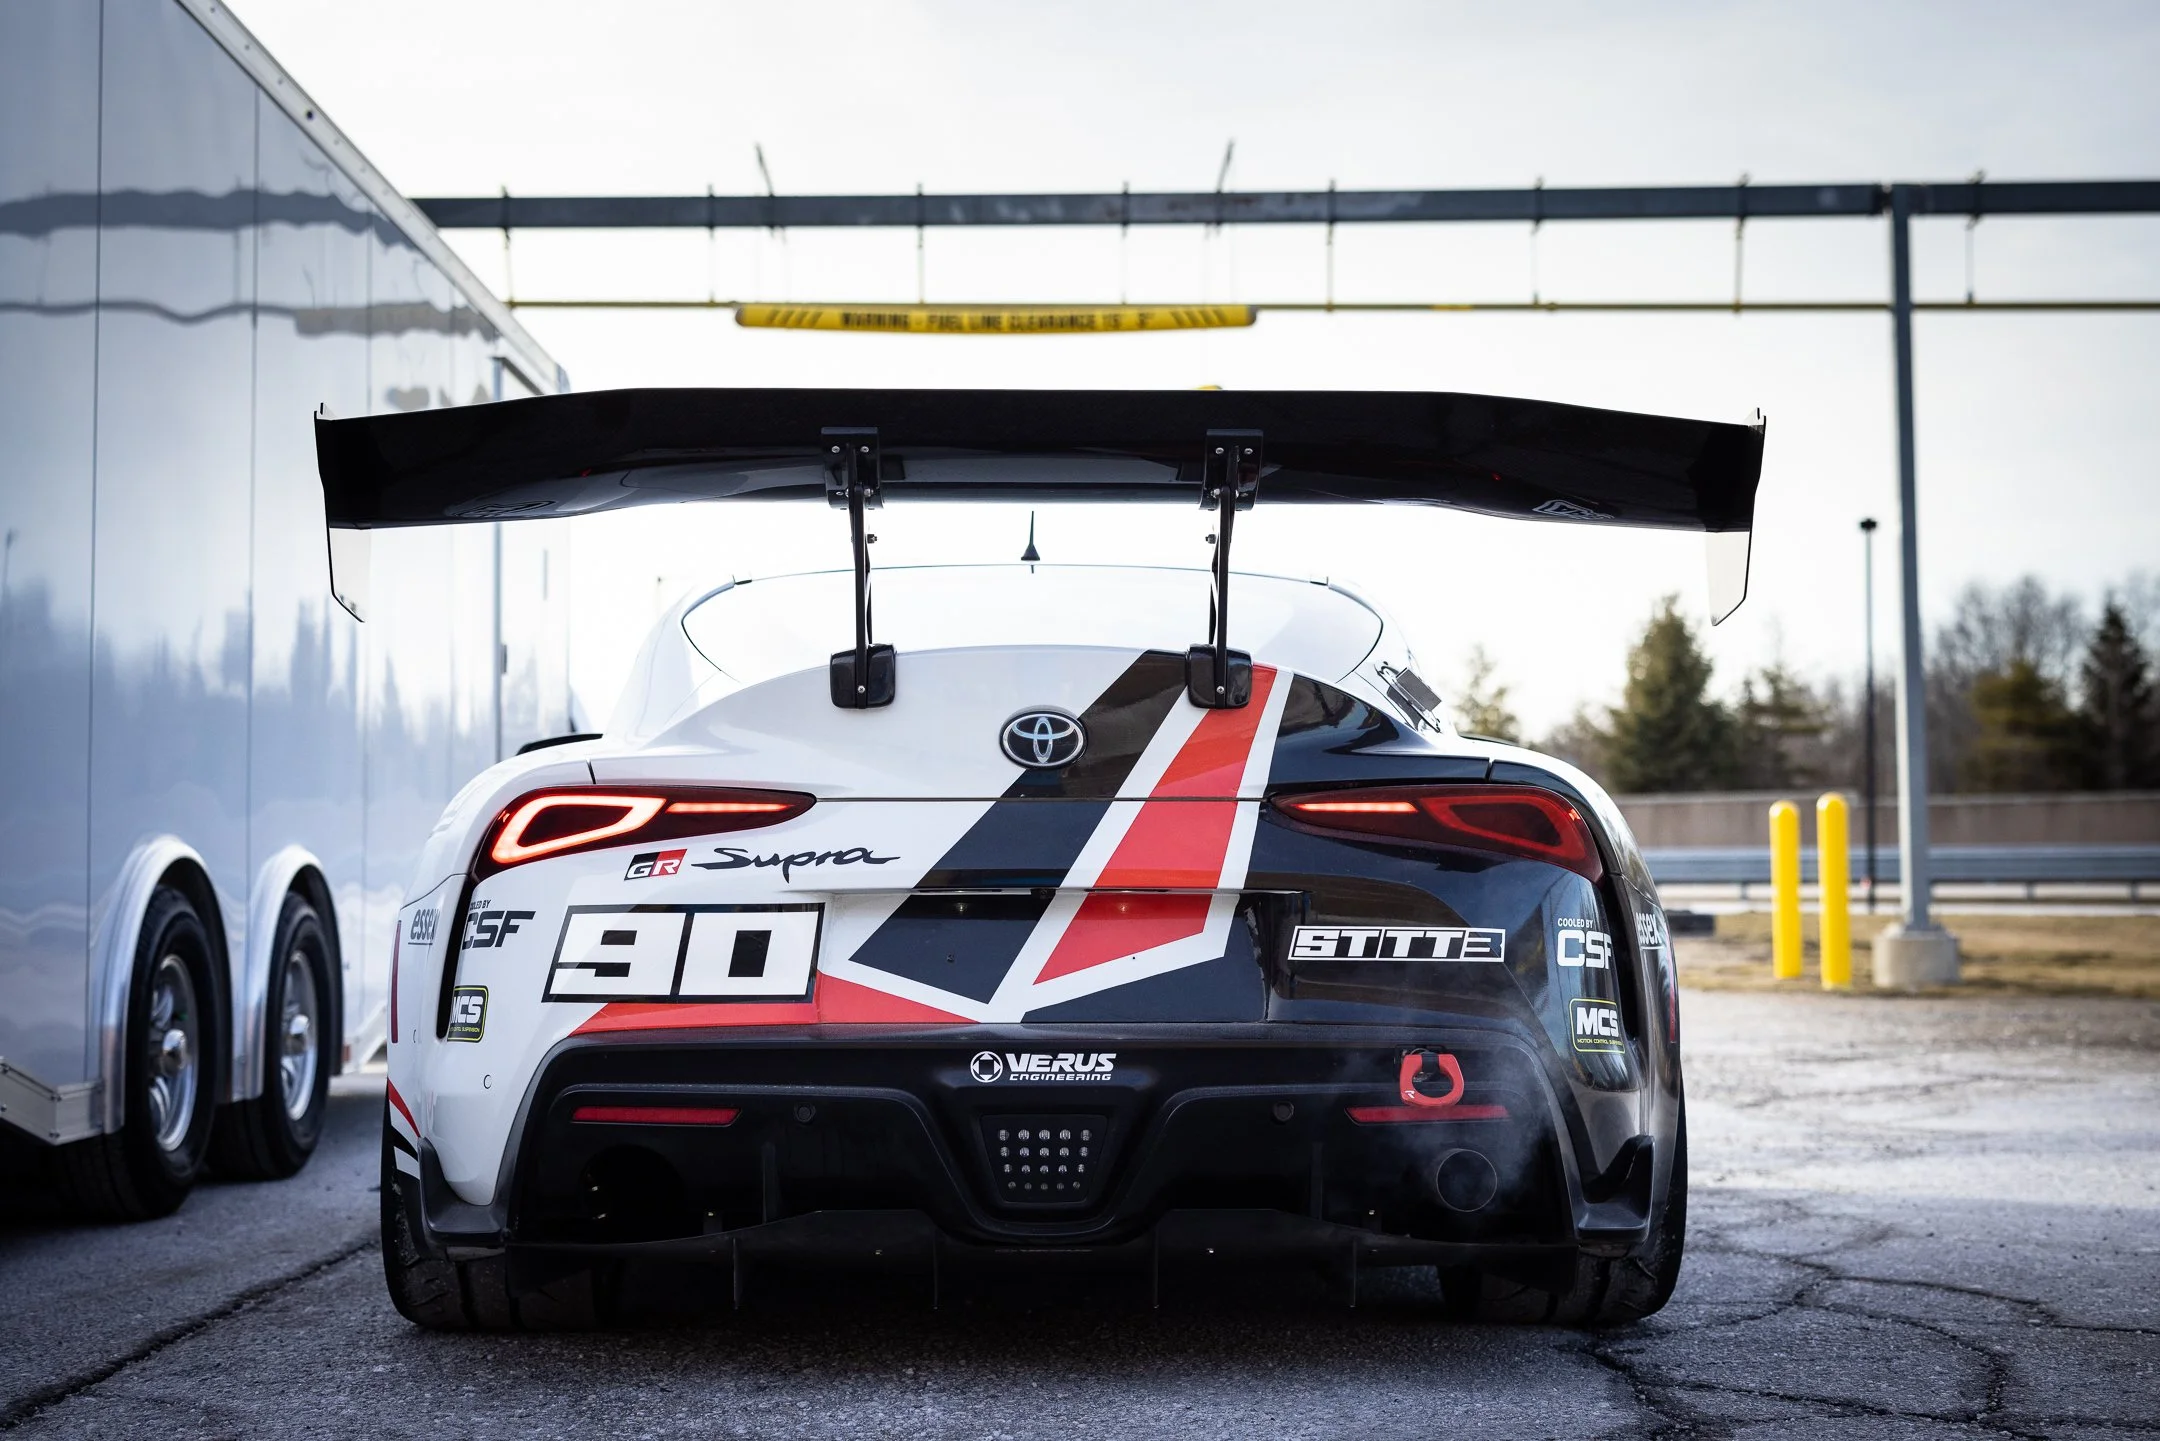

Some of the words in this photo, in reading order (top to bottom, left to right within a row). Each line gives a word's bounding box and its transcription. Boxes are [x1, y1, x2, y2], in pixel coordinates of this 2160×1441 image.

[842, 311, 909, 329] WARNING
[928, 313, 962, 331] FUEL
[970, 313, 1001, 331] LINE
[1009, 313, 1096, 331] CLEARANCE
[626, 856, 682, 880] GR
[691, 847, 901, 884] Supra
[482, 899, 491, 909] BY
[462, 910, 536, 950] CSF
[1557, 918, 1585, 928] COOLED
[1585, 919, 1594, 928] BY
[549, 911, 819, 996] 90
[1557, 929, 1612, 970] CSF
[1576, 1006, 1619, 1037] MCS
[1005, 1053, 1117, 1073] VERUS
